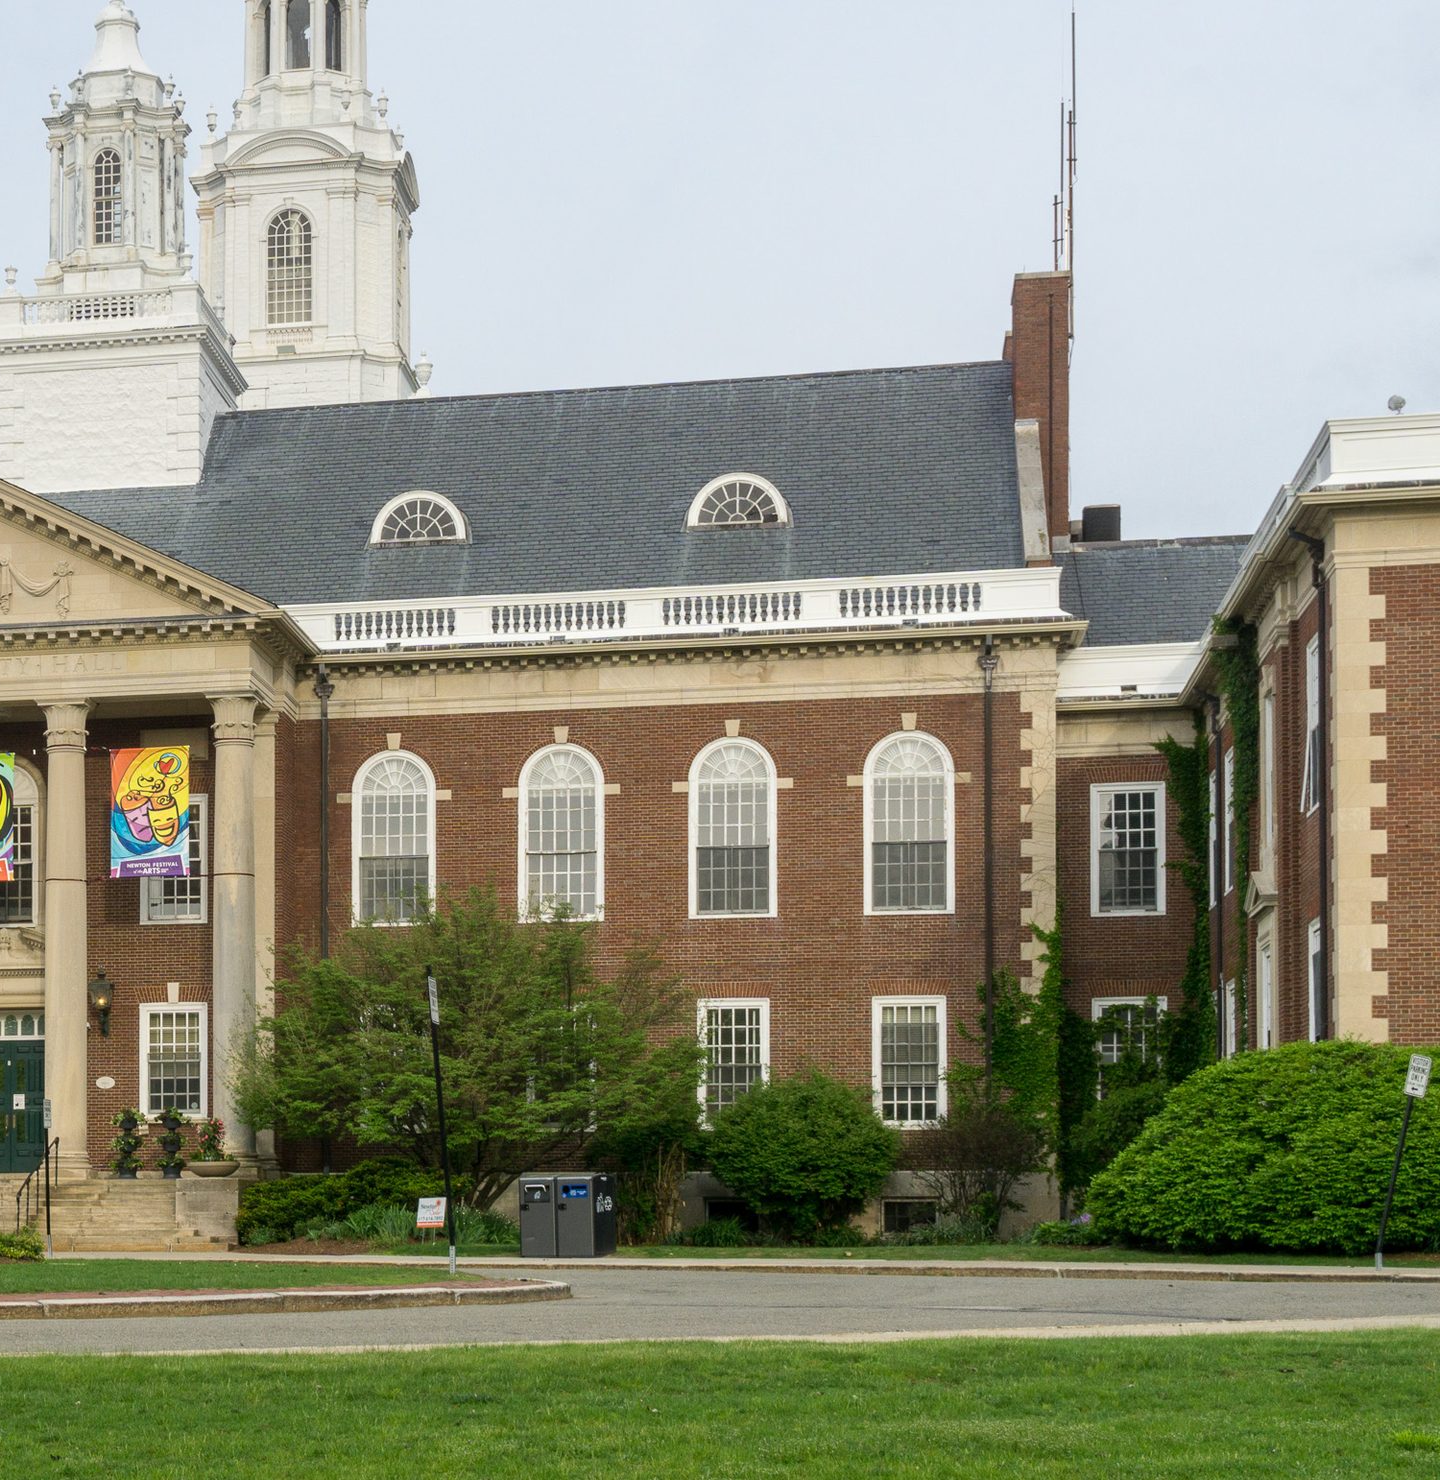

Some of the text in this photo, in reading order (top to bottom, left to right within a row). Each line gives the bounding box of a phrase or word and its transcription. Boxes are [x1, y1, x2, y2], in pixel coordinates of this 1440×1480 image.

[52, 653, 122, 673] HALL
[1412, 1057, 1429, 1066] VISITOR
[1410, 1064, 1428, 1075] PARKING
[1411, 1073, 1424, 1082] ONLY
